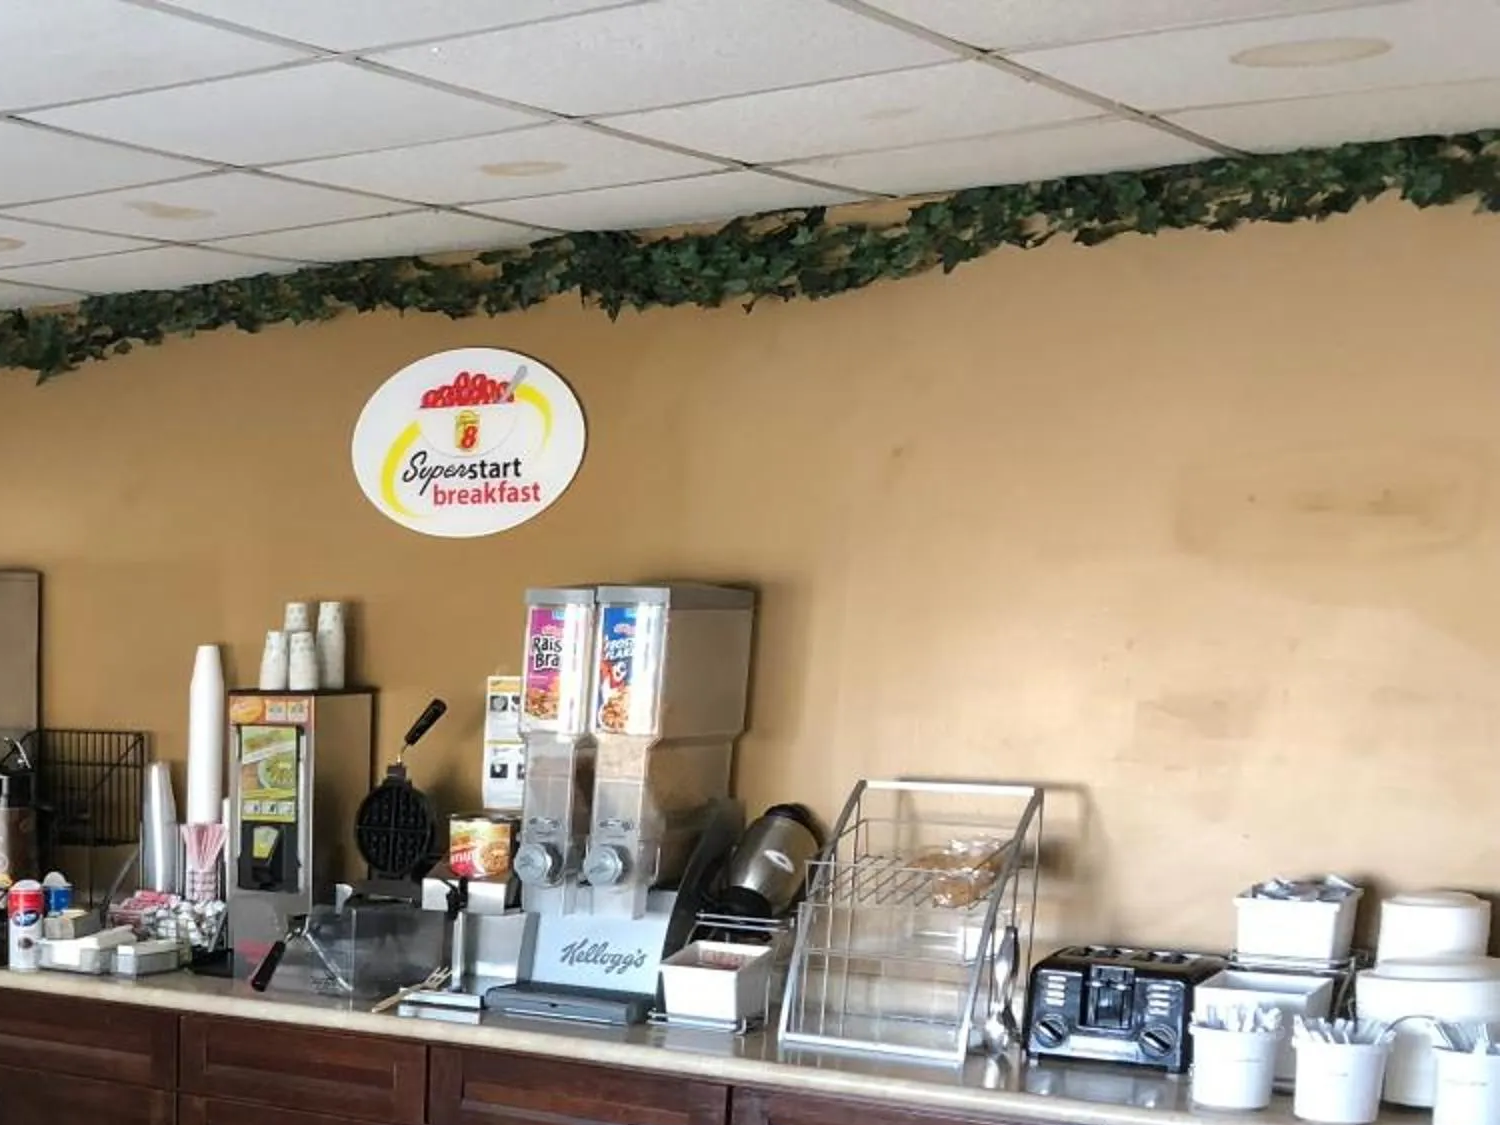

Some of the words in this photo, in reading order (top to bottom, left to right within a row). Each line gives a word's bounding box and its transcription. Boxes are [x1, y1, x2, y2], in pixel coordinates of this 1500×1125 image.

[460, 424, 478, 449] 8
[402, 450, 522, 496] Superstart
[432, 480, 542, 506] breakfast
[560, 938, 648, 974] Kellogg's
